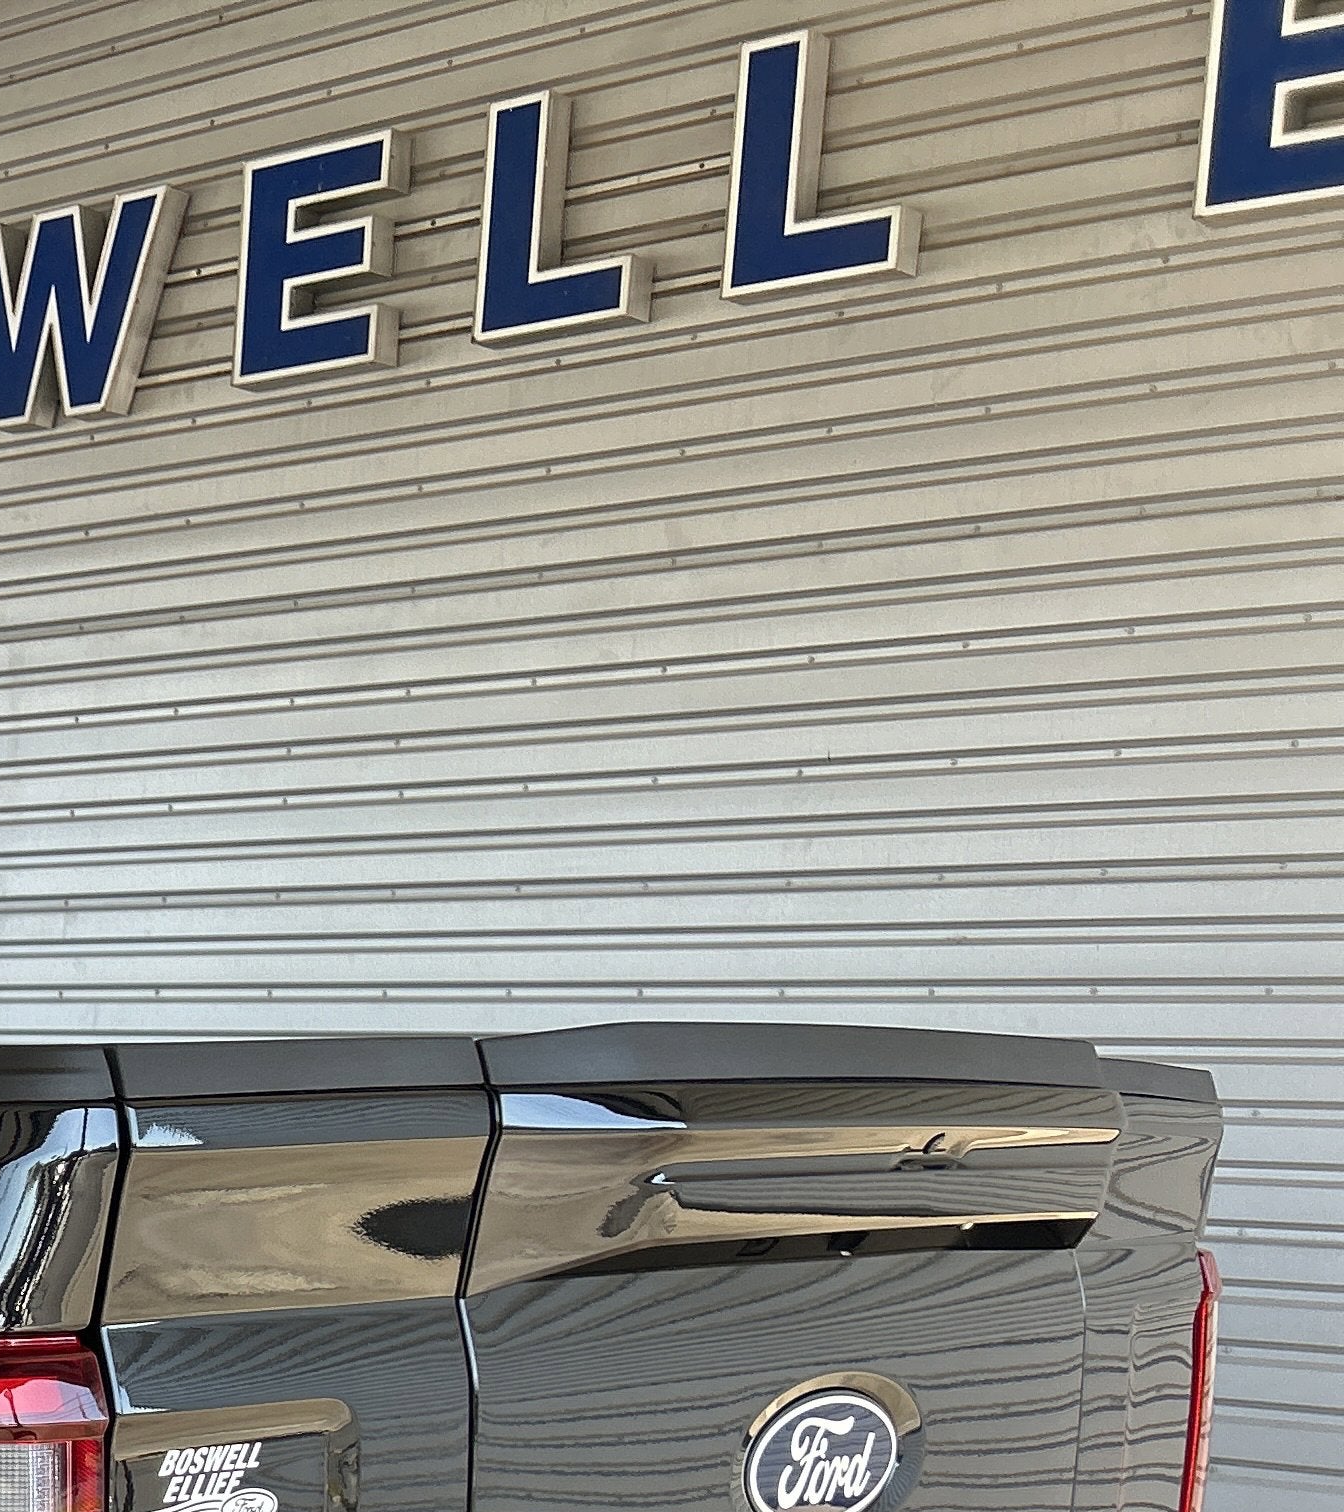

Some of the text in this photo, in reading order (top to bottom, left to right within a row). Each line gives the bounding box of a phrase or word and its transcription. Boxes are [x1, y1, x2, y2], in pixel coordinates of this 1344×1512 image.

[158, 1441, 262, 1477] BOSWELL
[777, 1415, 874, 1509] Ford
[163, 1471, 244, 1503] ELLIFF
